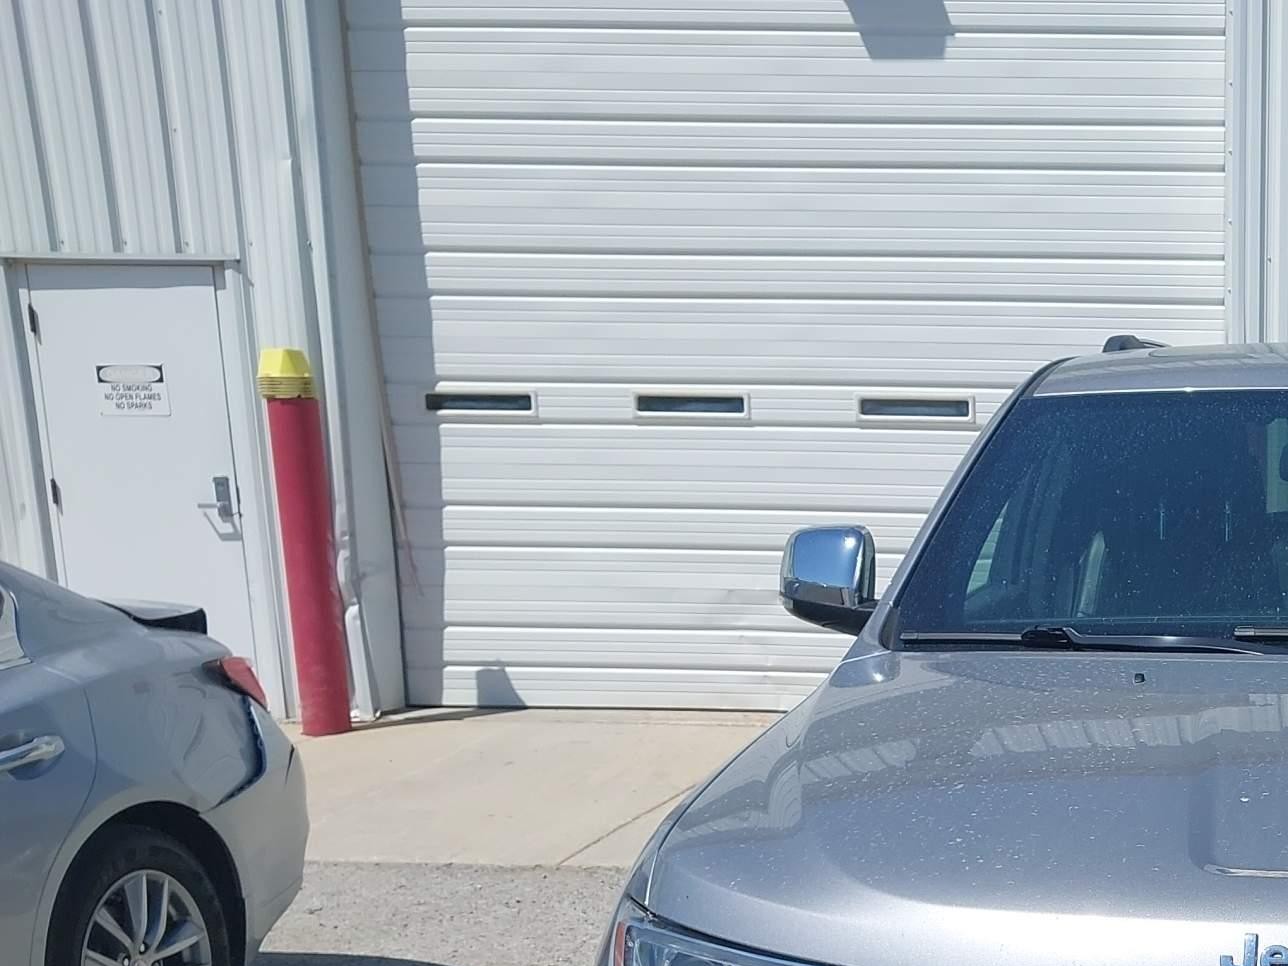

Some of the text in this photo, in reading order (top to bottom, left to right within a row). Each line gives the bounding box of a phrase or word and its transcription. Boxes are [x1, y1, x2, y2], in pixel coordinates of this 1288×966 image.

[111, 384, 152, 392] NO SMOKING
[104, 393, 161, 401] NO OPEN FLAMES
[115, 401, 152, 410] NO SPARKS
